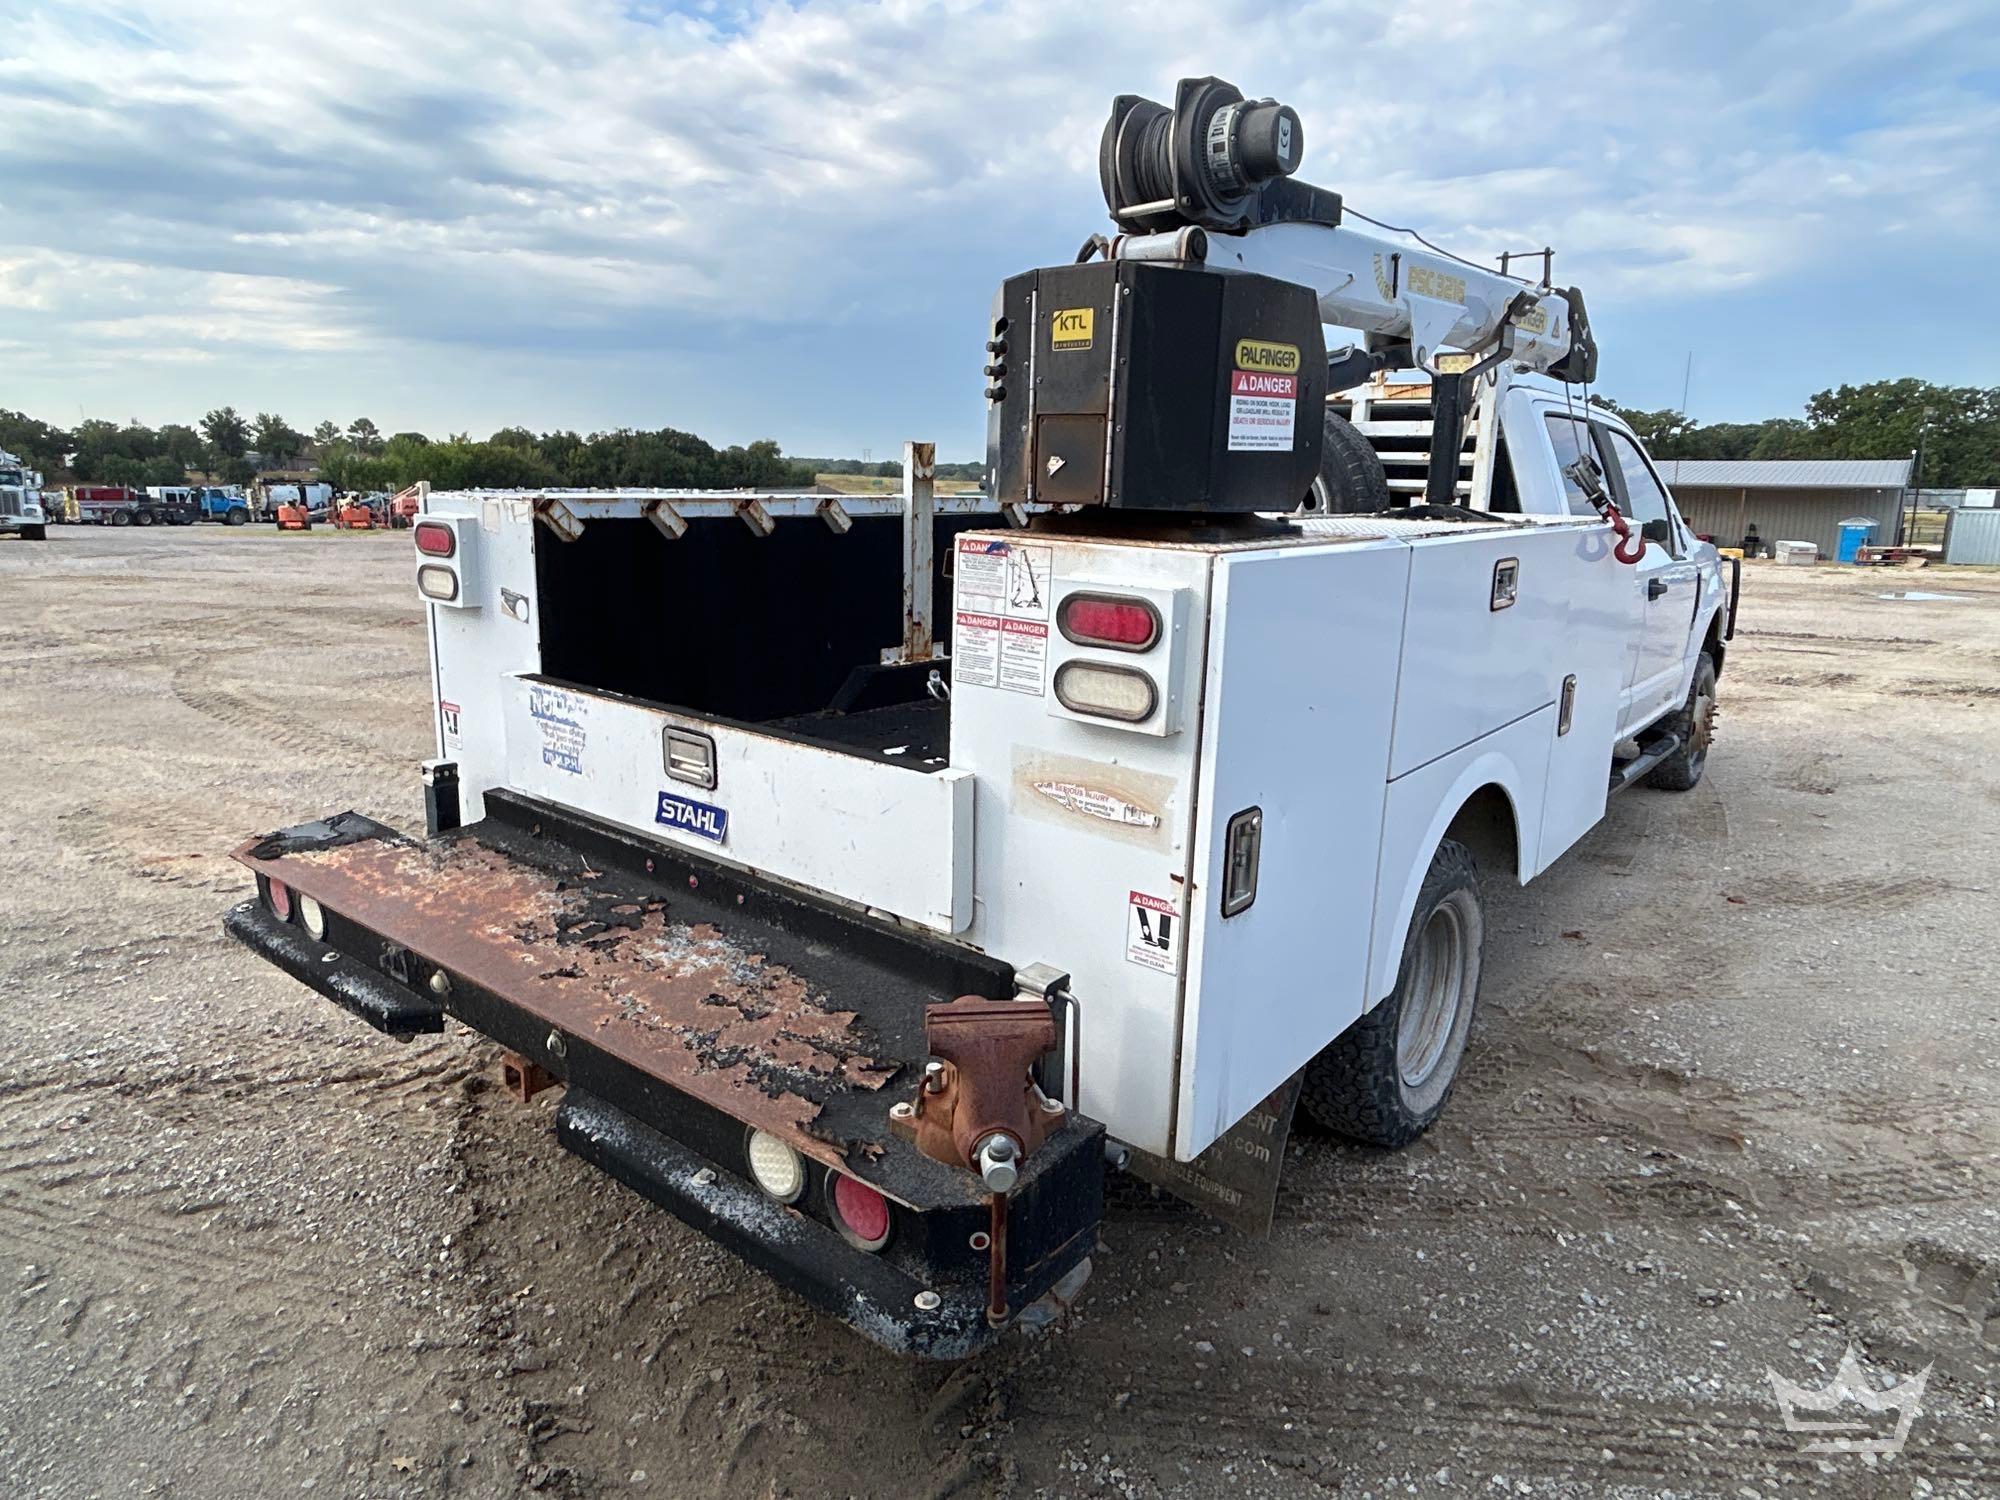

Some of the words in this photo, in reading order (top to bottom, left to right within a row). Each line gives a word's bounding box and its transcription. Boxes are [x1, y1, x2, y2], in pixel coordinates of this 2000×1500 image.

[1060, 315, 1086, 331] KTL
[1240, 346, 1296, 368] PALFINGER
[1249, 376, 1292, 394] DANGER
[967, 616, 998, 628] DANGER
[1012, 624, 1046, 635] DANGER
[1085, 791, 1109, 802] INJURY
[662, 799, 720, 834] STAHL
[1142, 898, 1176, 914] DANGER
